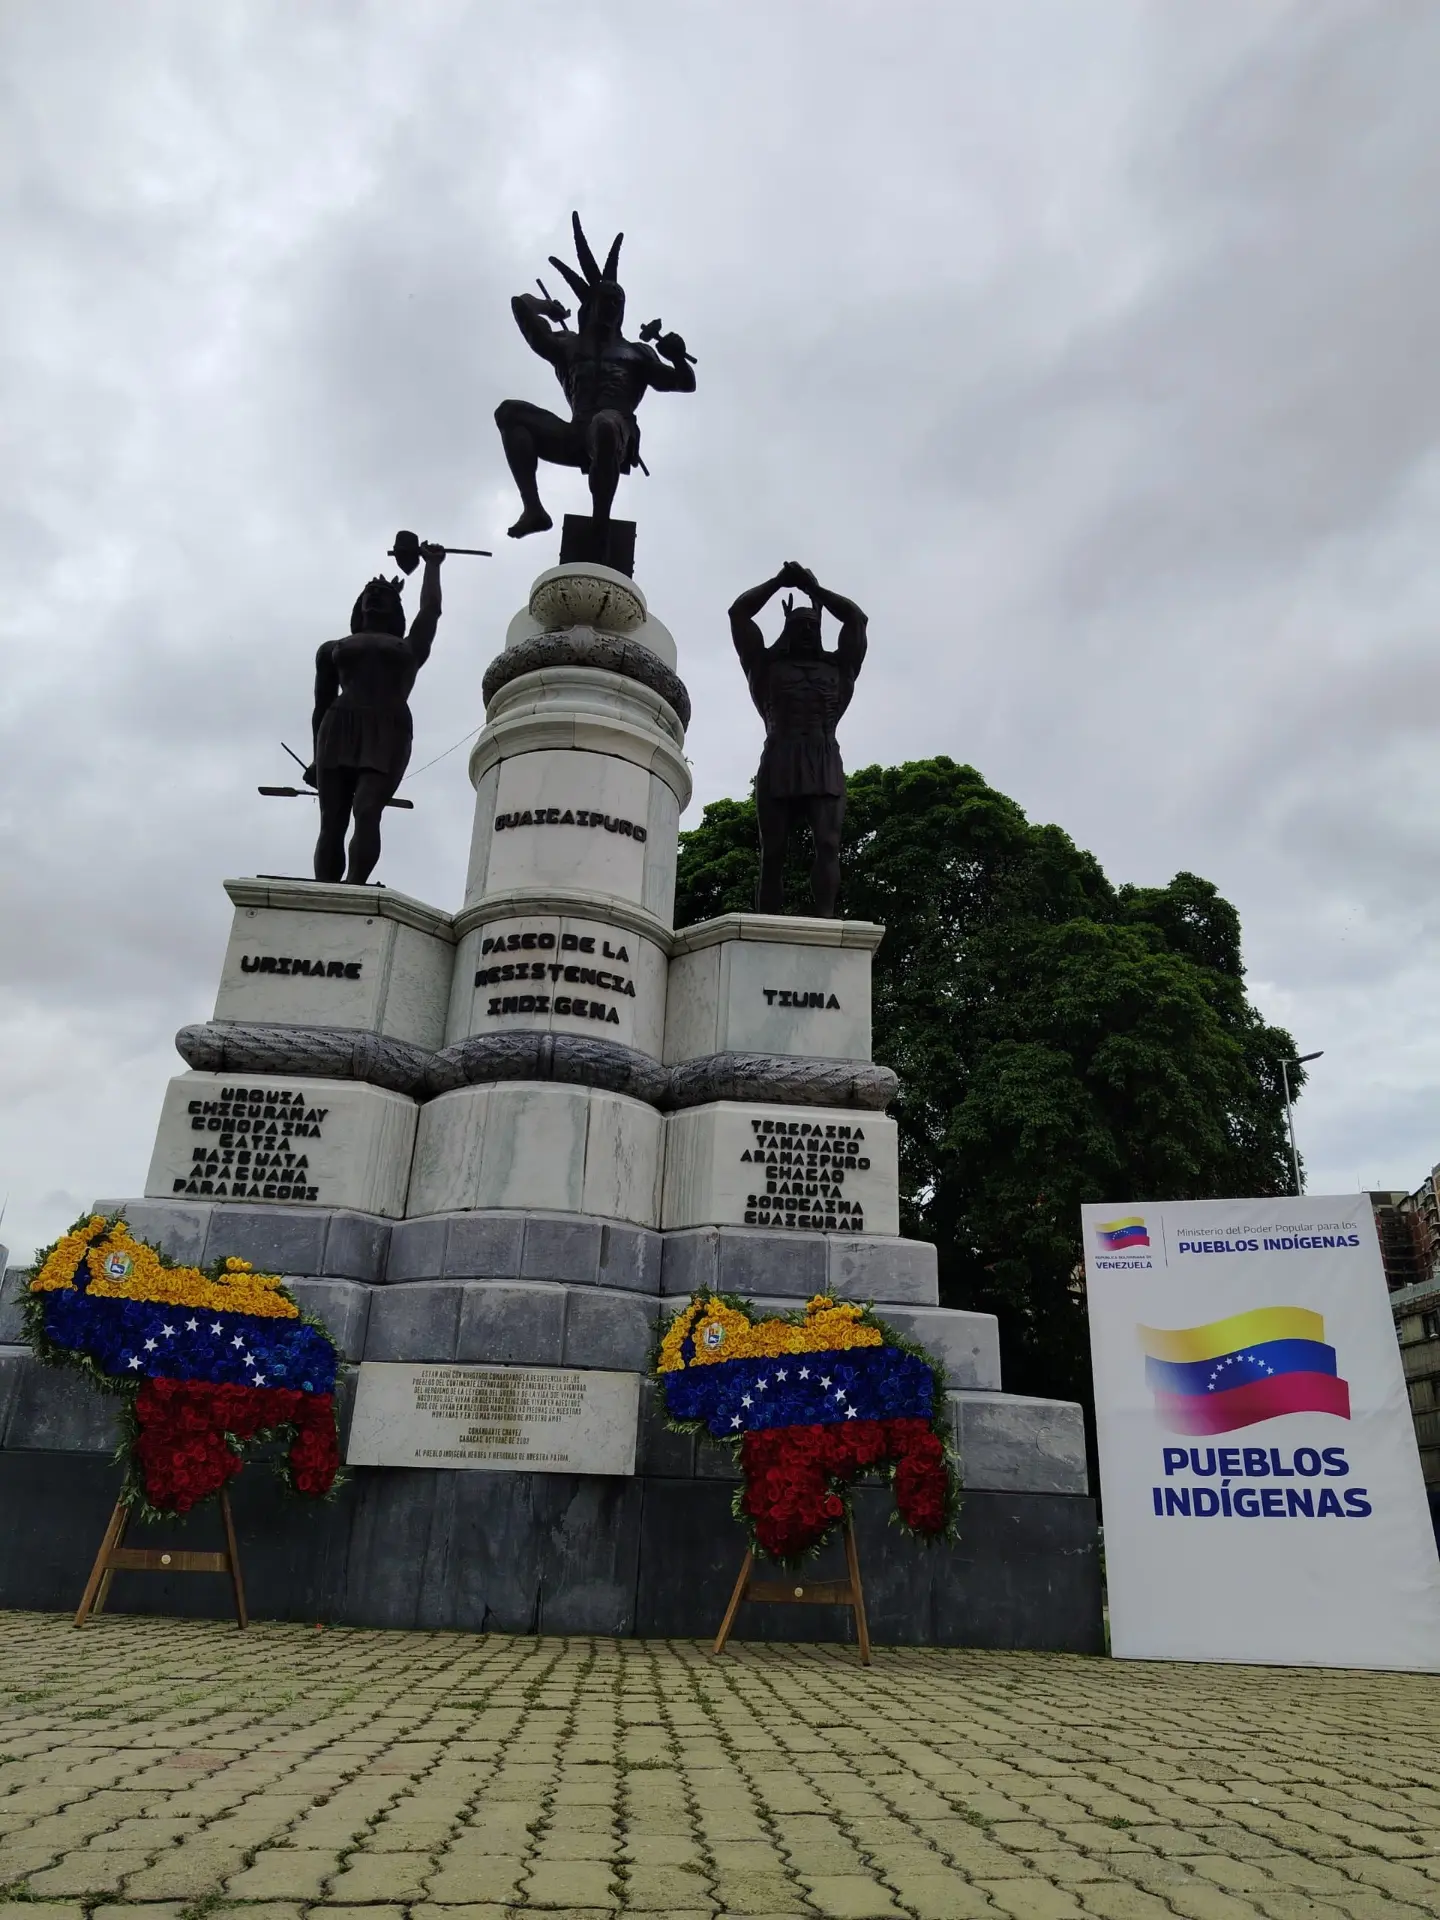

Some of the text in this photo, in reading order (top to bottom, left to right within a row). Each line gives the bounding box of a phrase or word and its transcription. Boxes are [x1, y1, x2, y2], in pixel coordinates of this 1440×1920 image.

[494, 808, 647, 843] GUAICAIPURO
[482, 933, 629, 962] PASEO DE LA
[240, 955, 363, 979] URIMARE
[474, 962, 636, 997] RESISTENCIA
[763, 988, 840, 1009] TIUNA
[487, 995, 619, 1024] INDIGENA
[221, 1087, 305, 1106] URQUIA
[188, 1101, 328, 1122] CHICURAMAY
[751, 1120, 865, 1140] TEREPAIMA
[219, 1133, 290, 1151] CATIA
[757, 1135, 860, 1154] TAMANACO
[192, 1148, 308, 1168] NAIGUATA
[740, 1150, 871, 1170] ARAMAIPURO
[189, 1164, 307, 1184] APACUANA
[766, 1166, 844, 1184] CHACAO
[173, 1179, 319, 1201] PARAMACONI
[766, 1181, 842, 1198] BARUTA
[747, 1195, 864, 1215] SOROCAIMA
[1177, 1221, 1357, 1237] Ministerio del Poder Popular para los
[1179, 1234, 1360, 1254] PUEBLOS INDÍGENAS
[1096, 1261, 1152, 1270] VENEZUELA
[1163, 1447, 1349, 1477] PUEBLOS
[1152, 1479, 1372, 1518] INDÍGENAS
